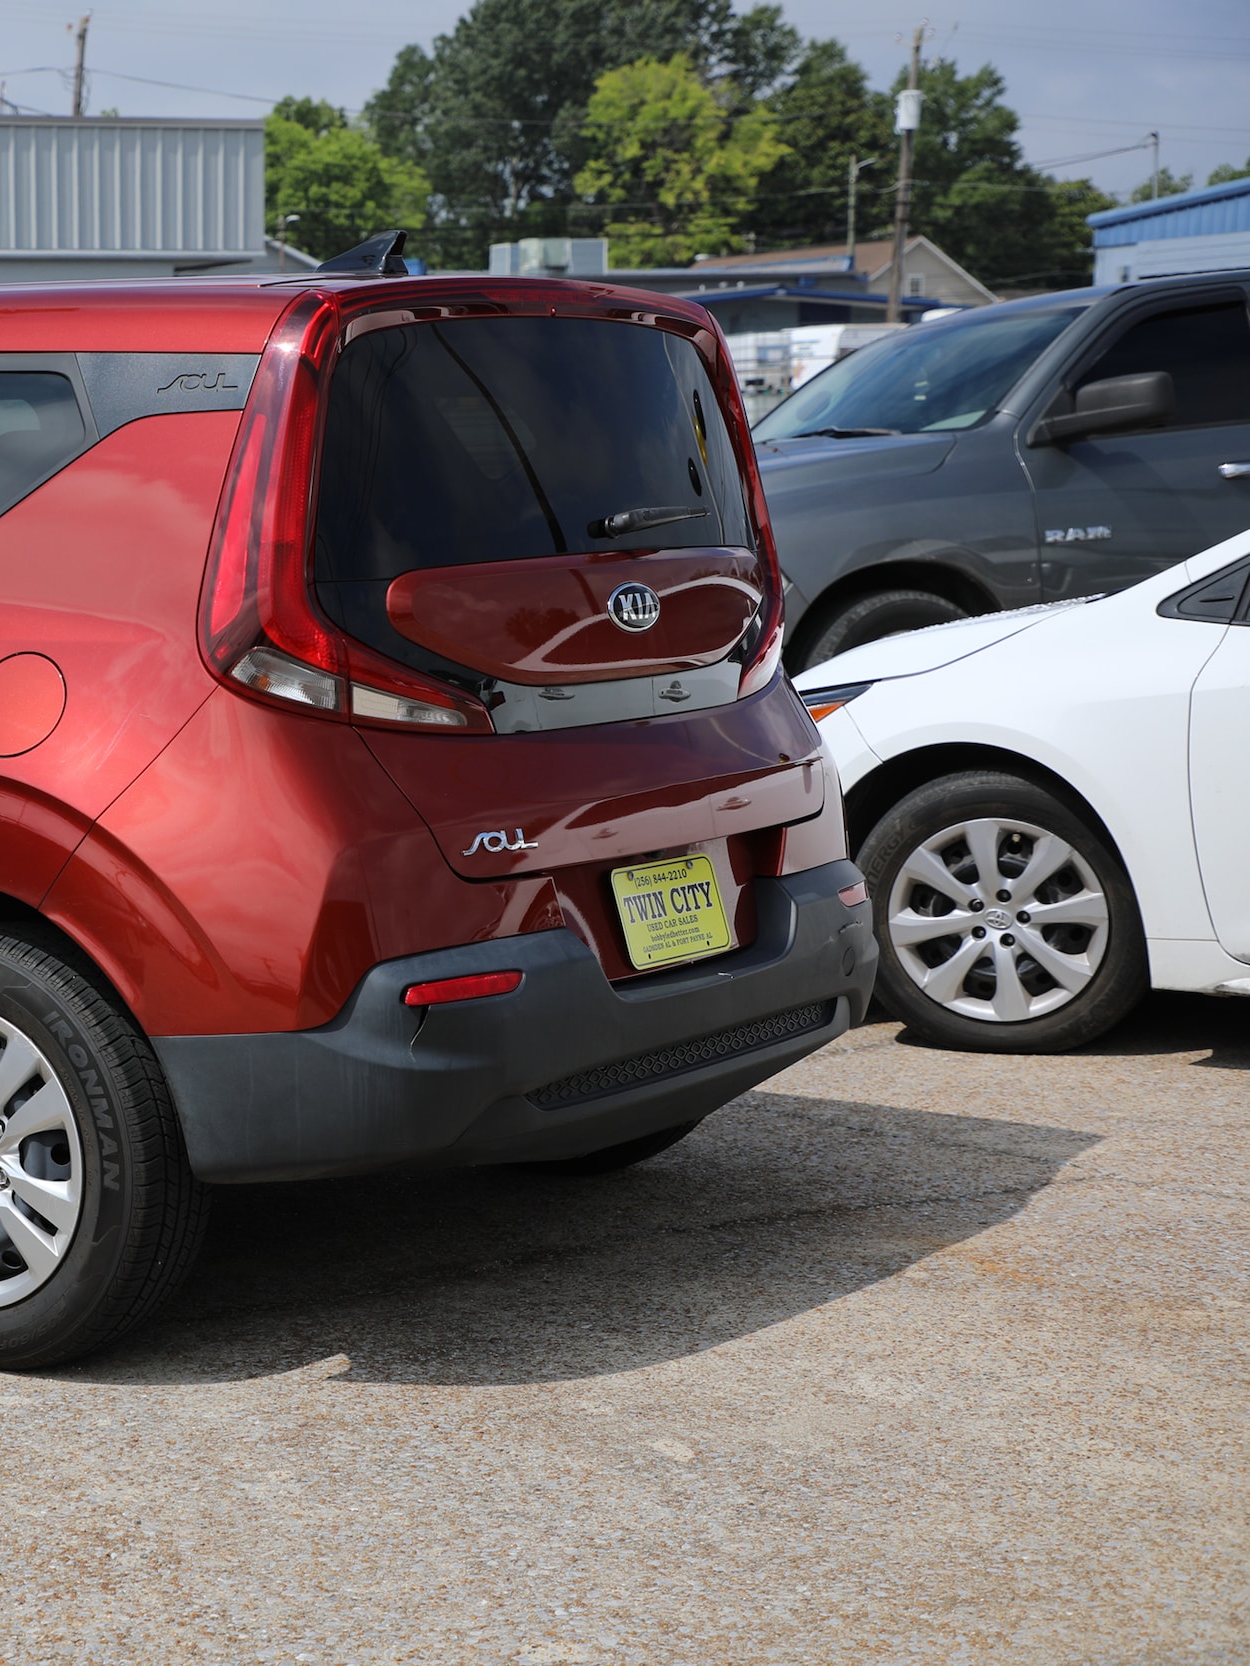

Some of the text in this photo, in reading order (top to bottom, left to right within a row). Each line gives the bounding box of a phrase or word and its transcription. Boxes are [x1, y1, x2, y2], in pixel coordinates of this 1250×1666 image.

[1045, 526, 1111, 542] RAM
[618, 592, 657, 621] KIA
[634, 868, 687, 889] (256) 844-2210
[624, 881, 713, 923] TWIN CITY
[647, 914, 698, 932] USED CAR SALES
[41, 1010, 121, 1191] IRONMAN
